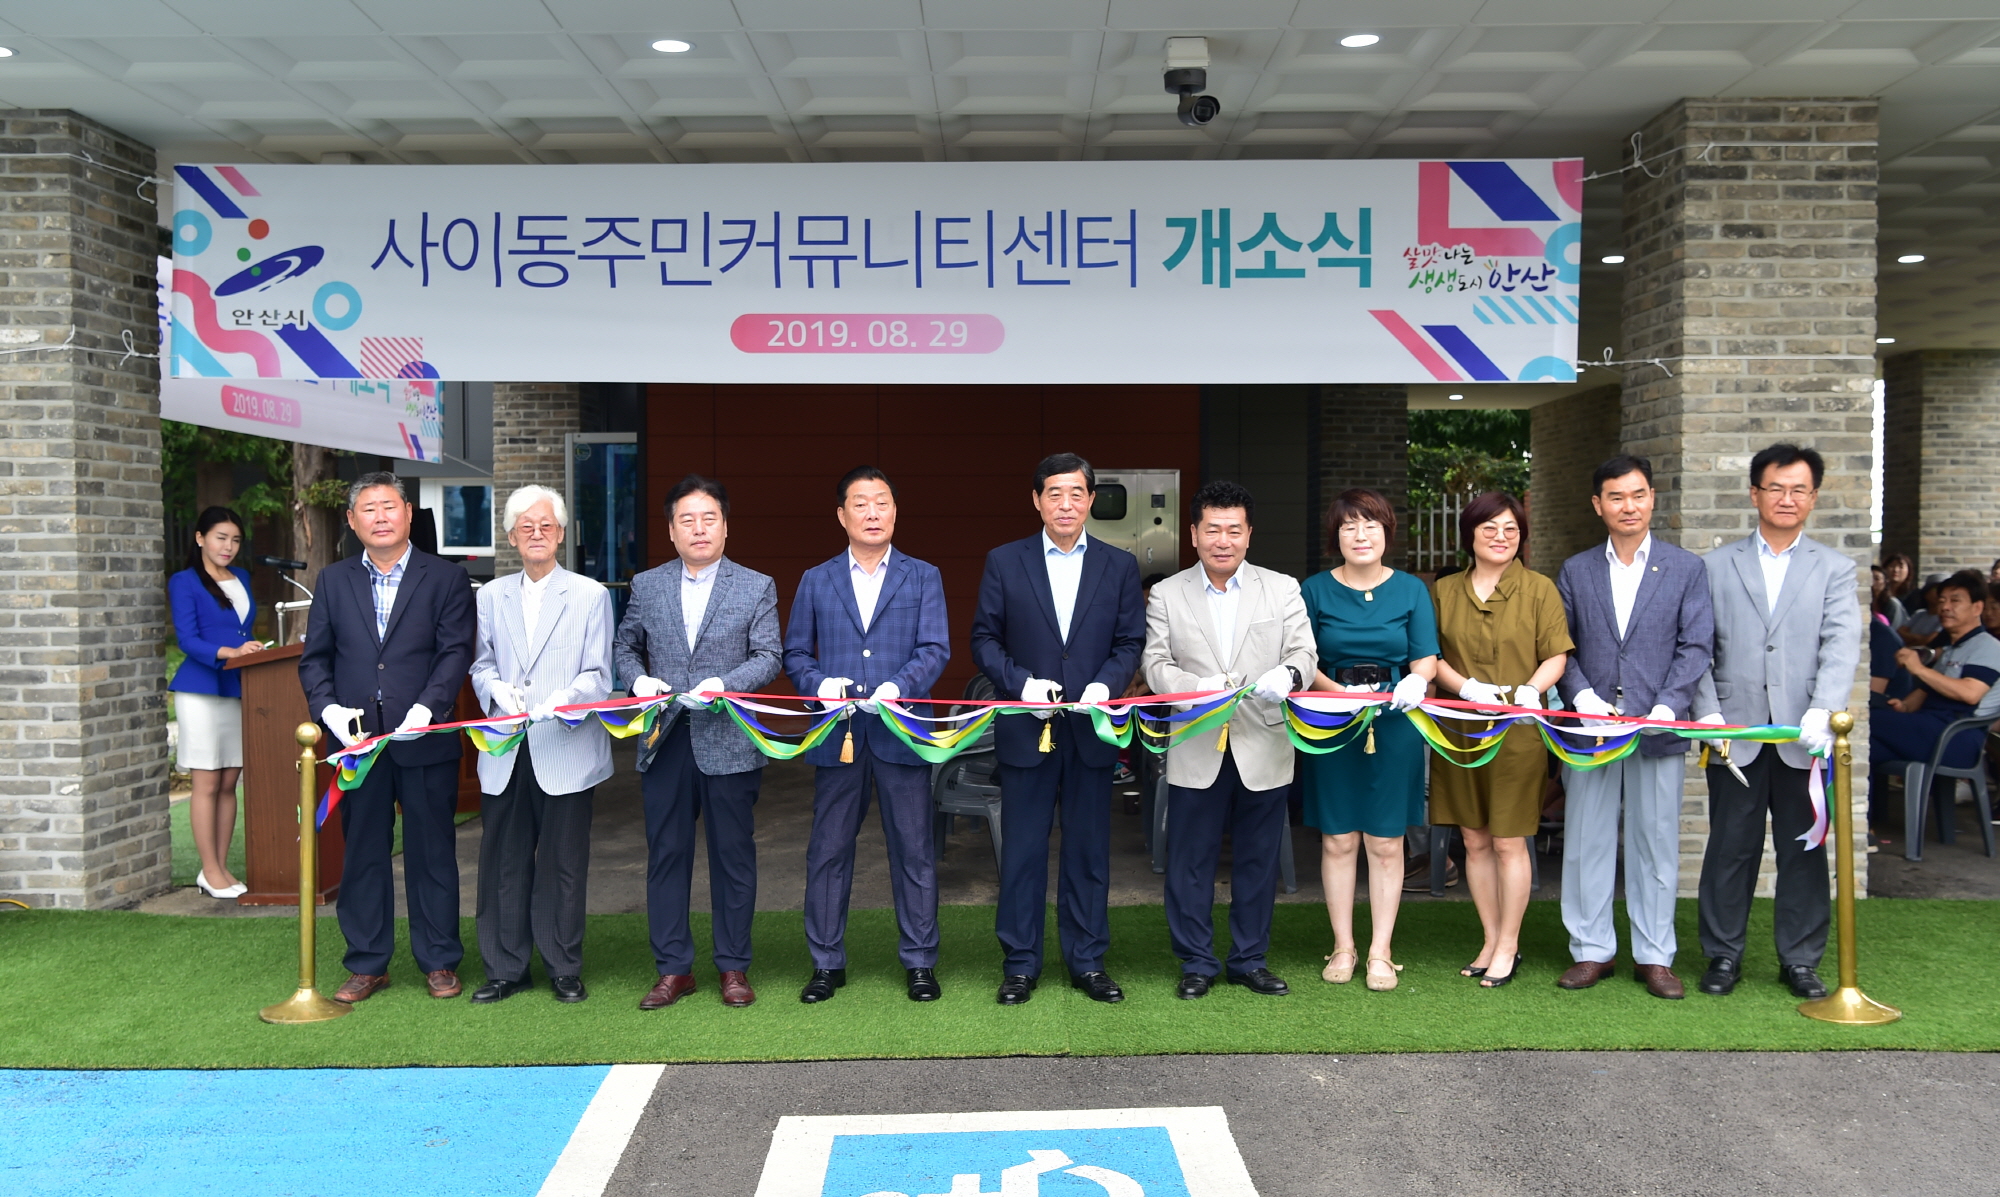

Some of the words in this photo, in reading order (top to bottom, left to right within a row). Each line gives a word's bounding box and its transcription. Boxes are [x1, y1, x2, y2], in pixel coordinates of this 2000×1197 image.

[370, 209, 1138, 288] 사이동주민커뮤니티센터
[1163, 207, 1372, 288] 개소식
[1488, 262, 1556, 292] 안산
[232, 309, 304, 326] 안산시
[767, 320, 857, 347] 2019.
[867, 320, 917, 348] 08.
[928, 320, 968, 347] 29
